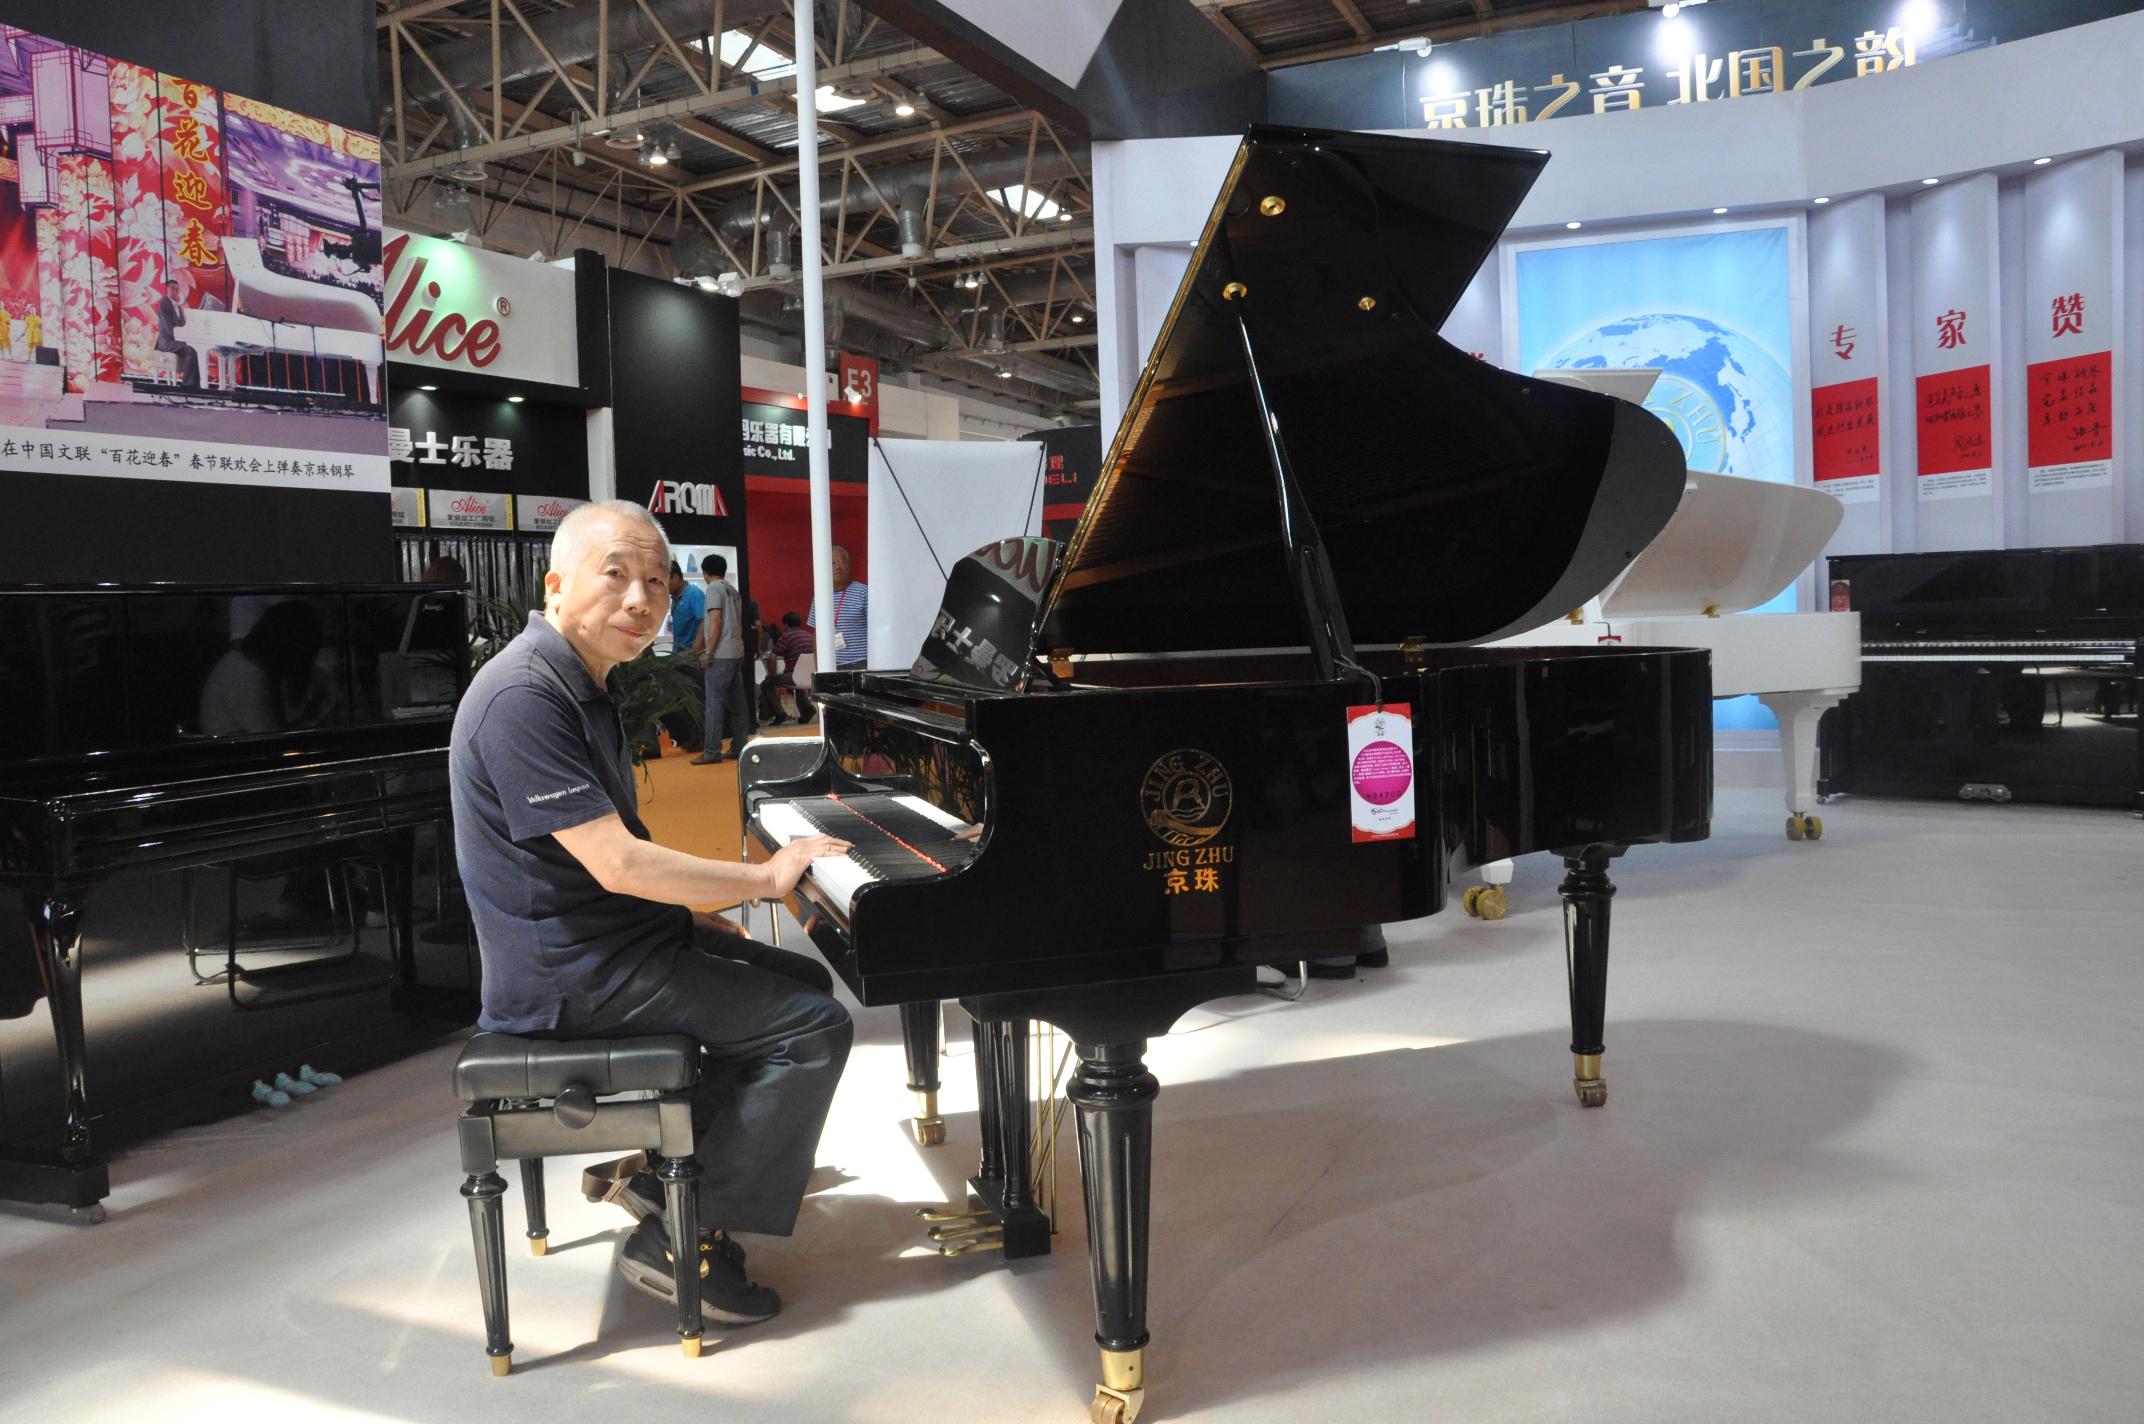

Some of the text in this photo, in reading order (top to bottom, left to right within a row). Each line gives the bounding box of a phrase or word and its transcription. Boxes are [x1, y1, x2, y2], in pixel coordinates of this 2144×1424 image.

[1419, 65, 1645, 129] 京珠之音
[171, 77, 218, 267] 百花迎春
[1830, 292, 2085, 360] 专 家 赞
[847, 368, 872, 398] E3
[388, 427, 514, 471] 曼士乐器
[1143, 846, 1234, 870] JING ZHU
[1164, 868, 1220, 895] 京珠
